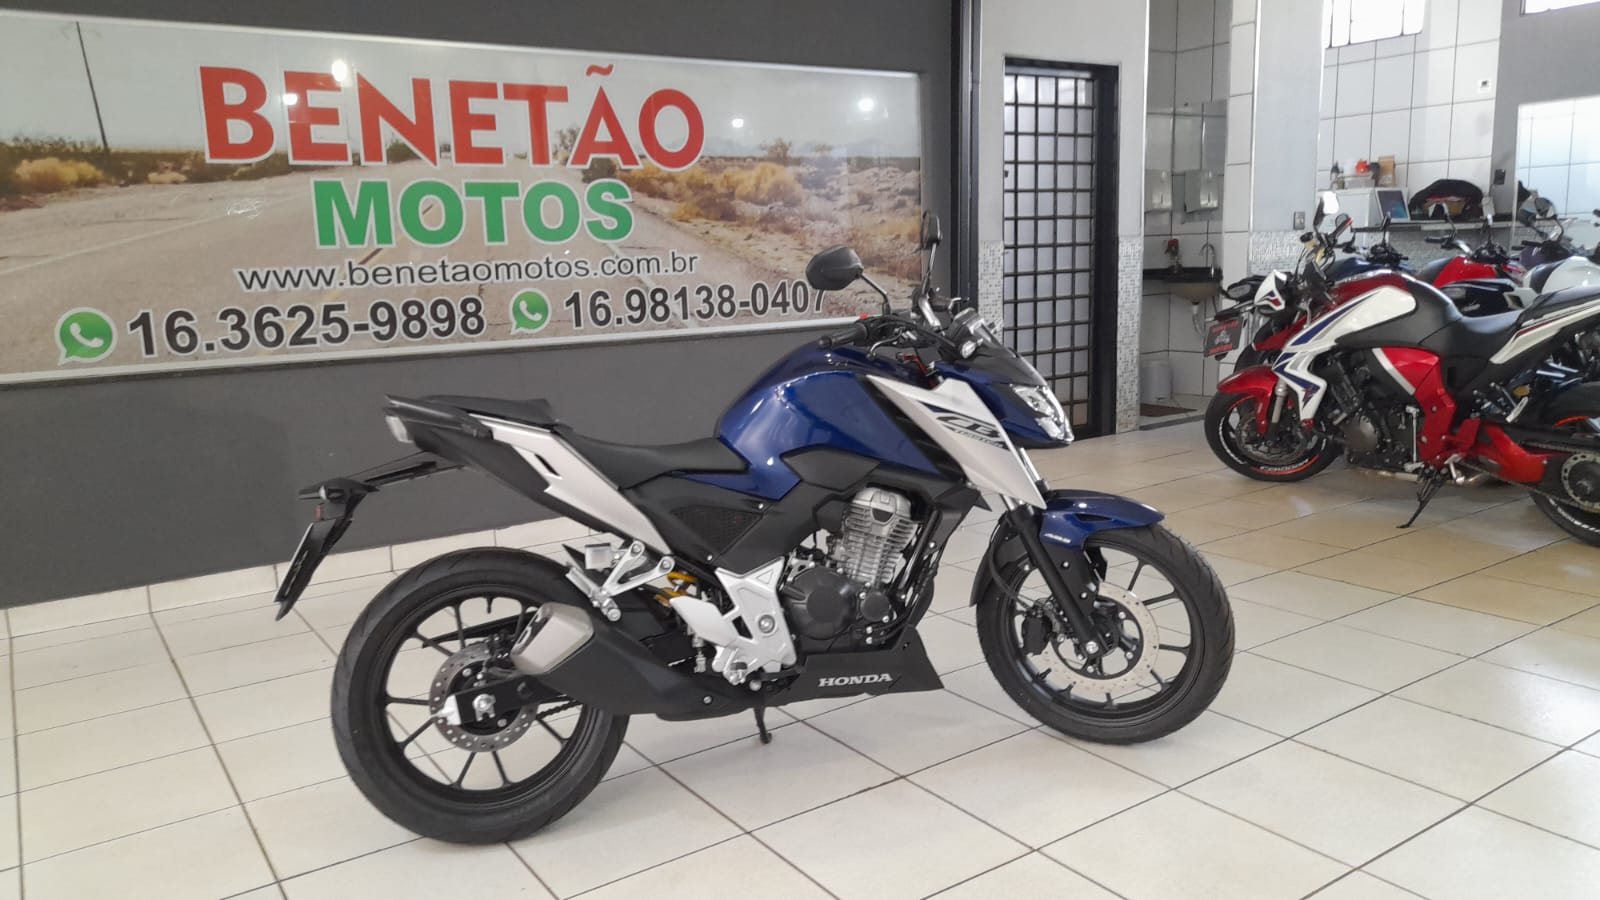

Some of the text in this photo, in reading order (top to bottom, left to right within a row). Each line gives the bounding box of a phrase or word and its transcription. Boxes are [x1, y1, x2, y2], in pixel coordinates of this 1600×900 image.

[200, 65, 705, 170] BENETÃO
[314, 179, 633, 246] MOTOS
[238, 251, 698, 290] www.benetaomotos.com.br
[128, 298, 485, 356] 16.3625-9898
[819, 673, 893, 687] HONDA
